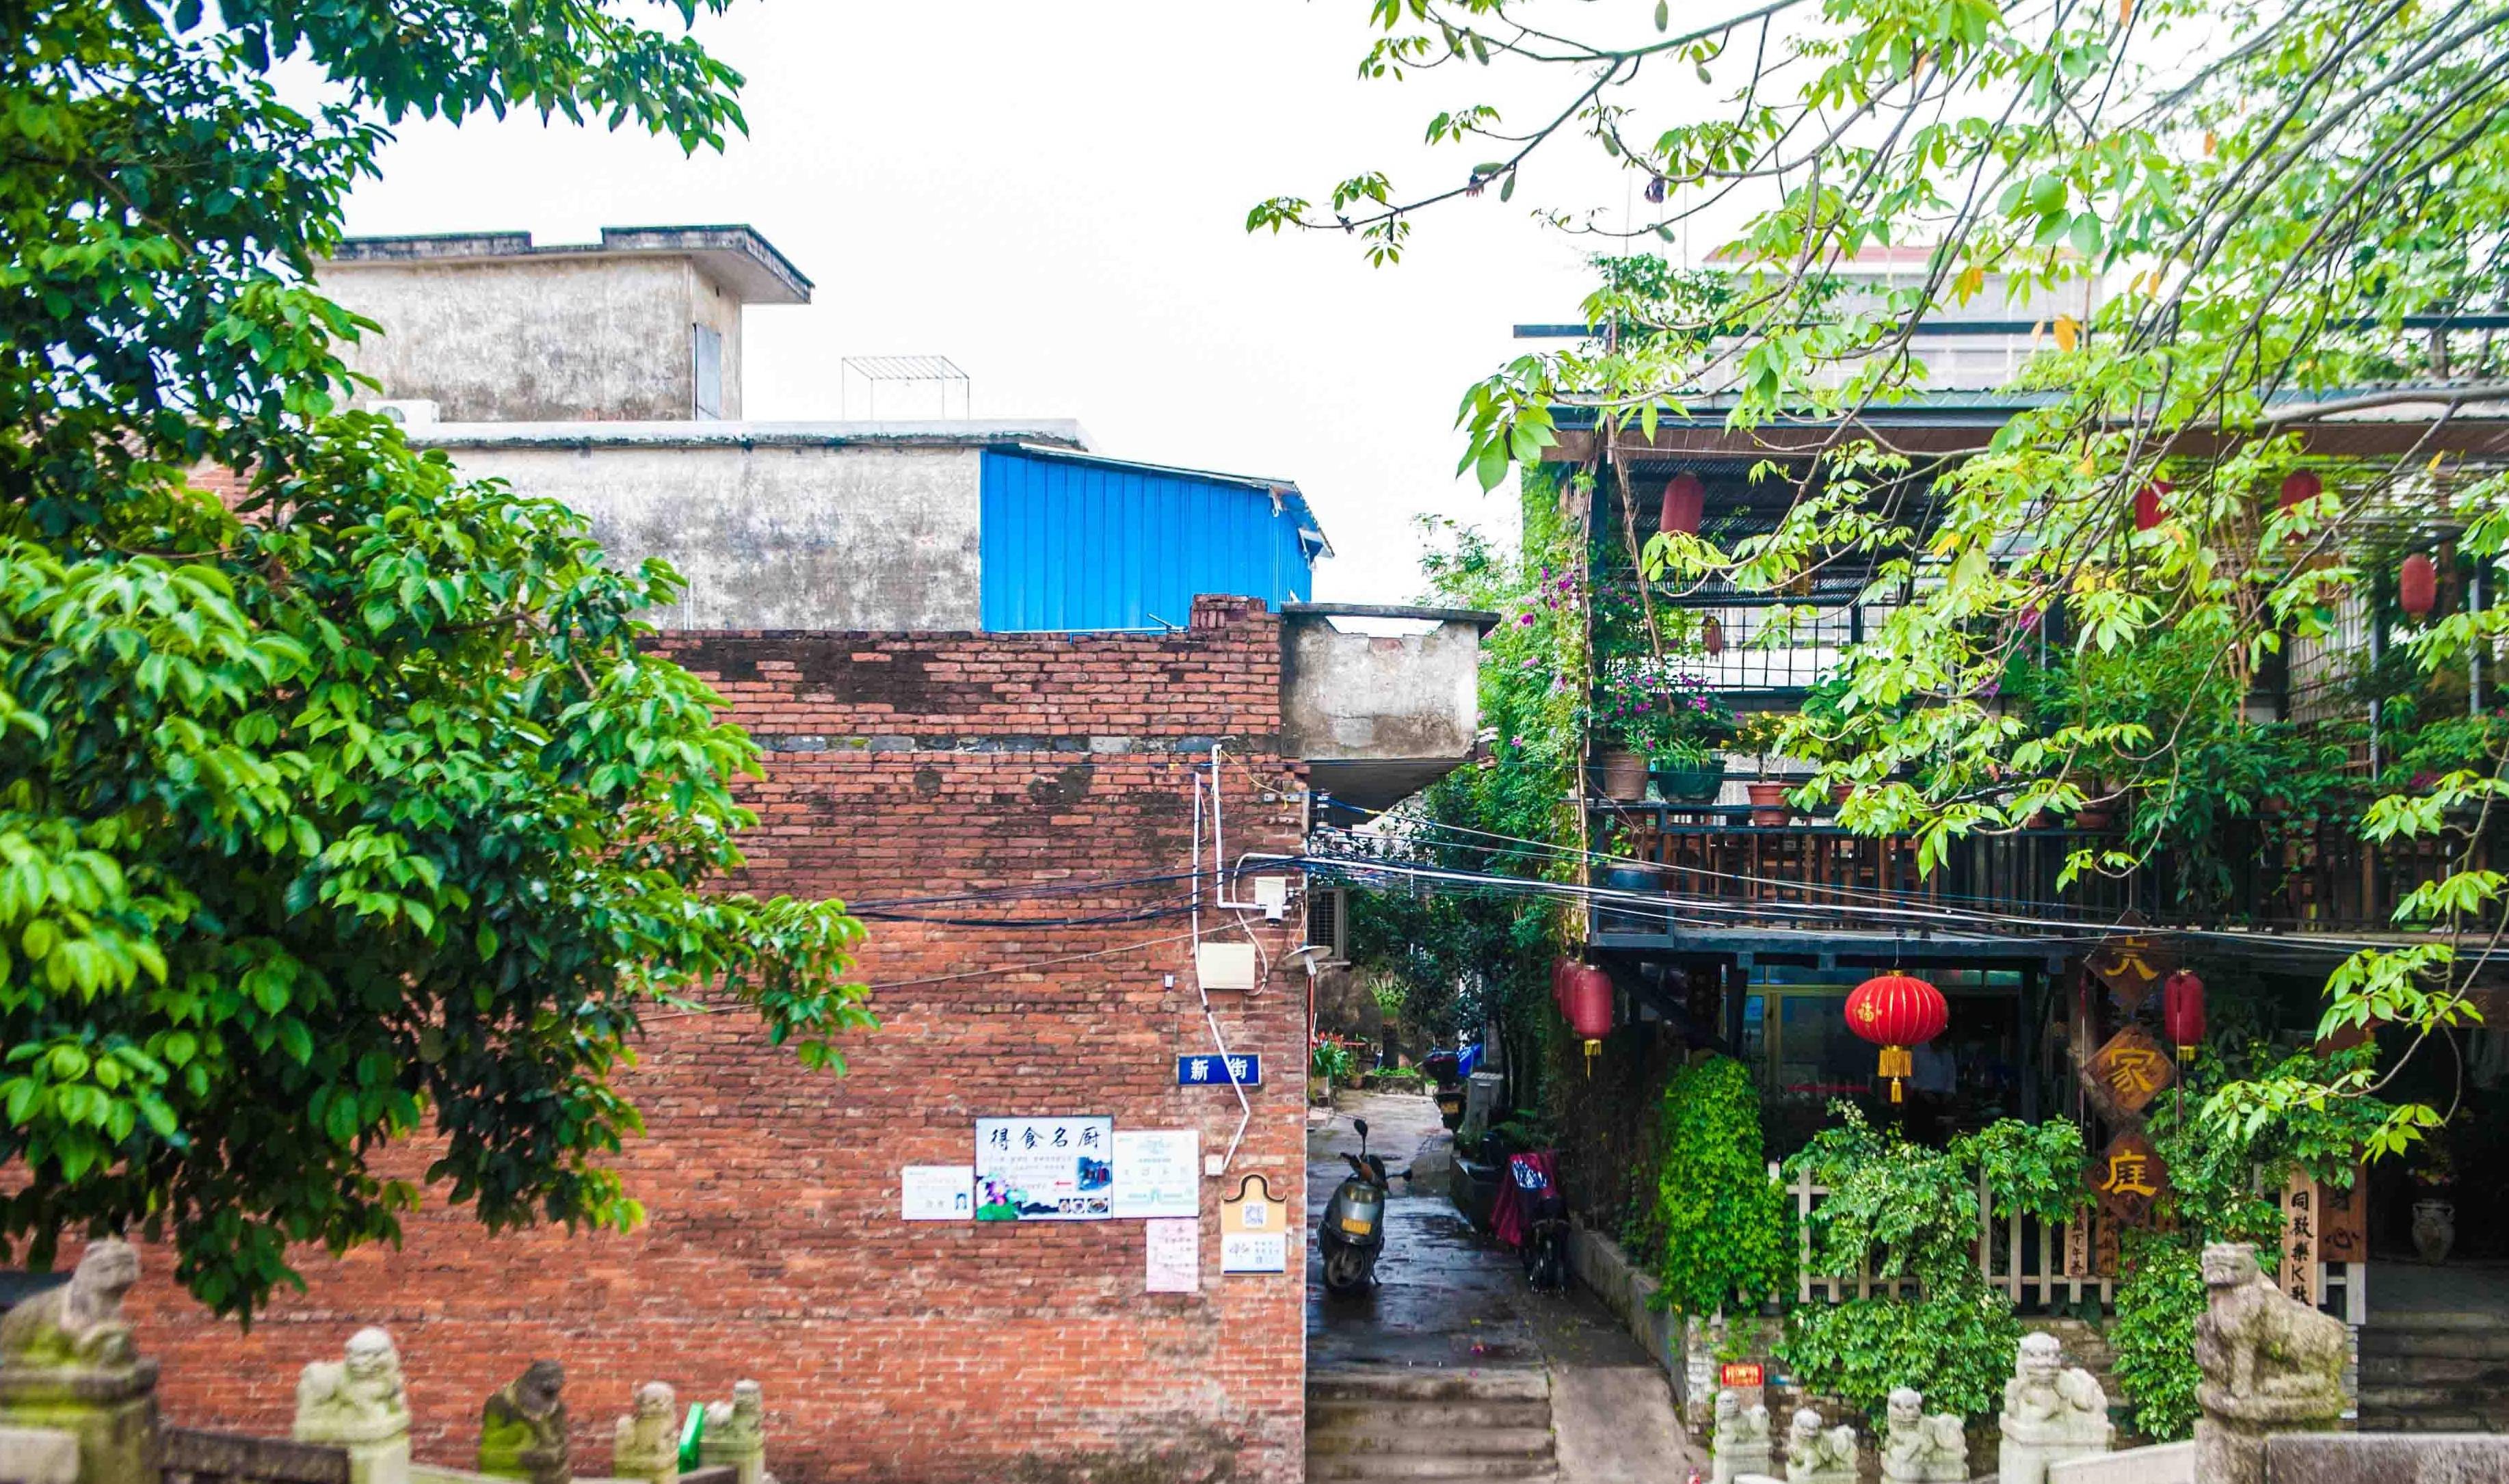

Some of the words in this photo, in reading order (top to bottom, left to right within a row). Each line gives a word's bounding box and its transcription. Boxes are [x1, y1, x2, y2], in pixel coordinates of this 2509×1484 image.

[1191, 1057, 1247, 1081] 新街
[990, 1126, 1101, 1151] 得食名厨
